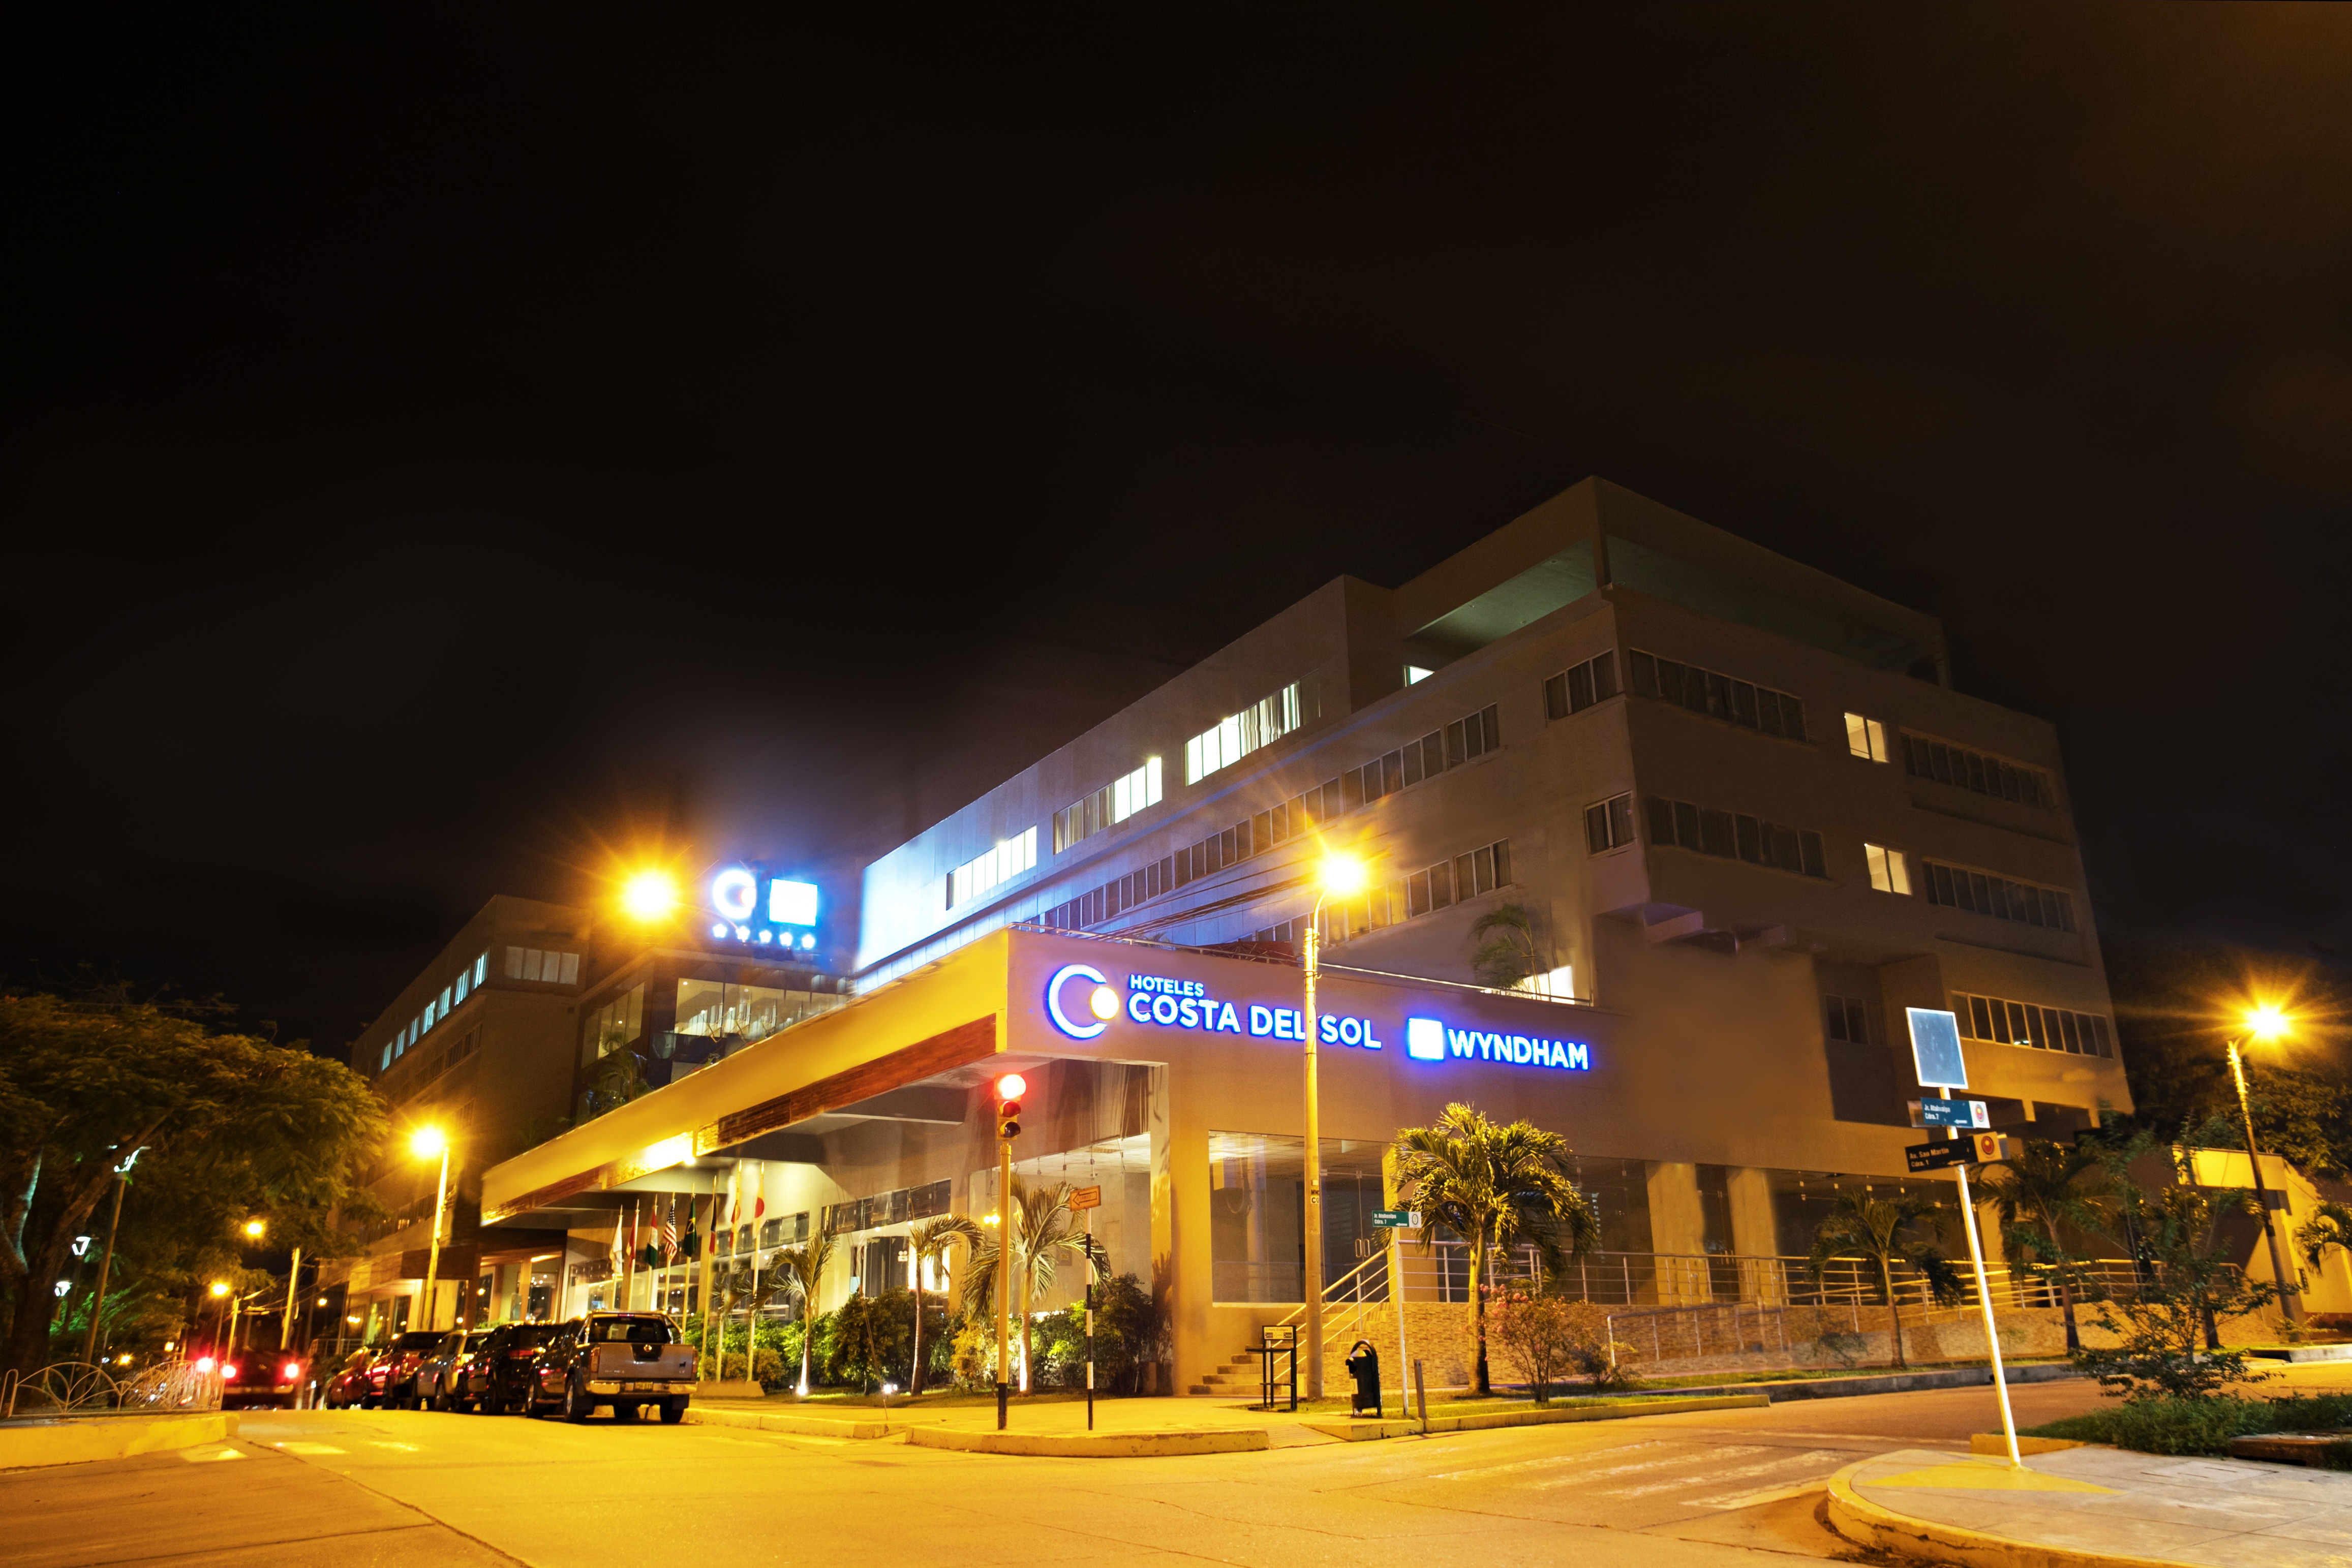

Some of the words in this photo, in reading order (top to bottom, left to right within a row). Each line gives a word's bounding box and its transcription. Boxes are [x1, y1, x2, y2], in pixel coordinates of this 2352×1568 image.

[1129, 974, 1204, 997] HOTELES
[1128, 992, 1241, 1033] COSTA
[1249, 1005, 1306, 1040] DEL
[1320, 1014, 1382, 1049] SOL
[1447, 1029, 1589, 1070] WYNDHAM
